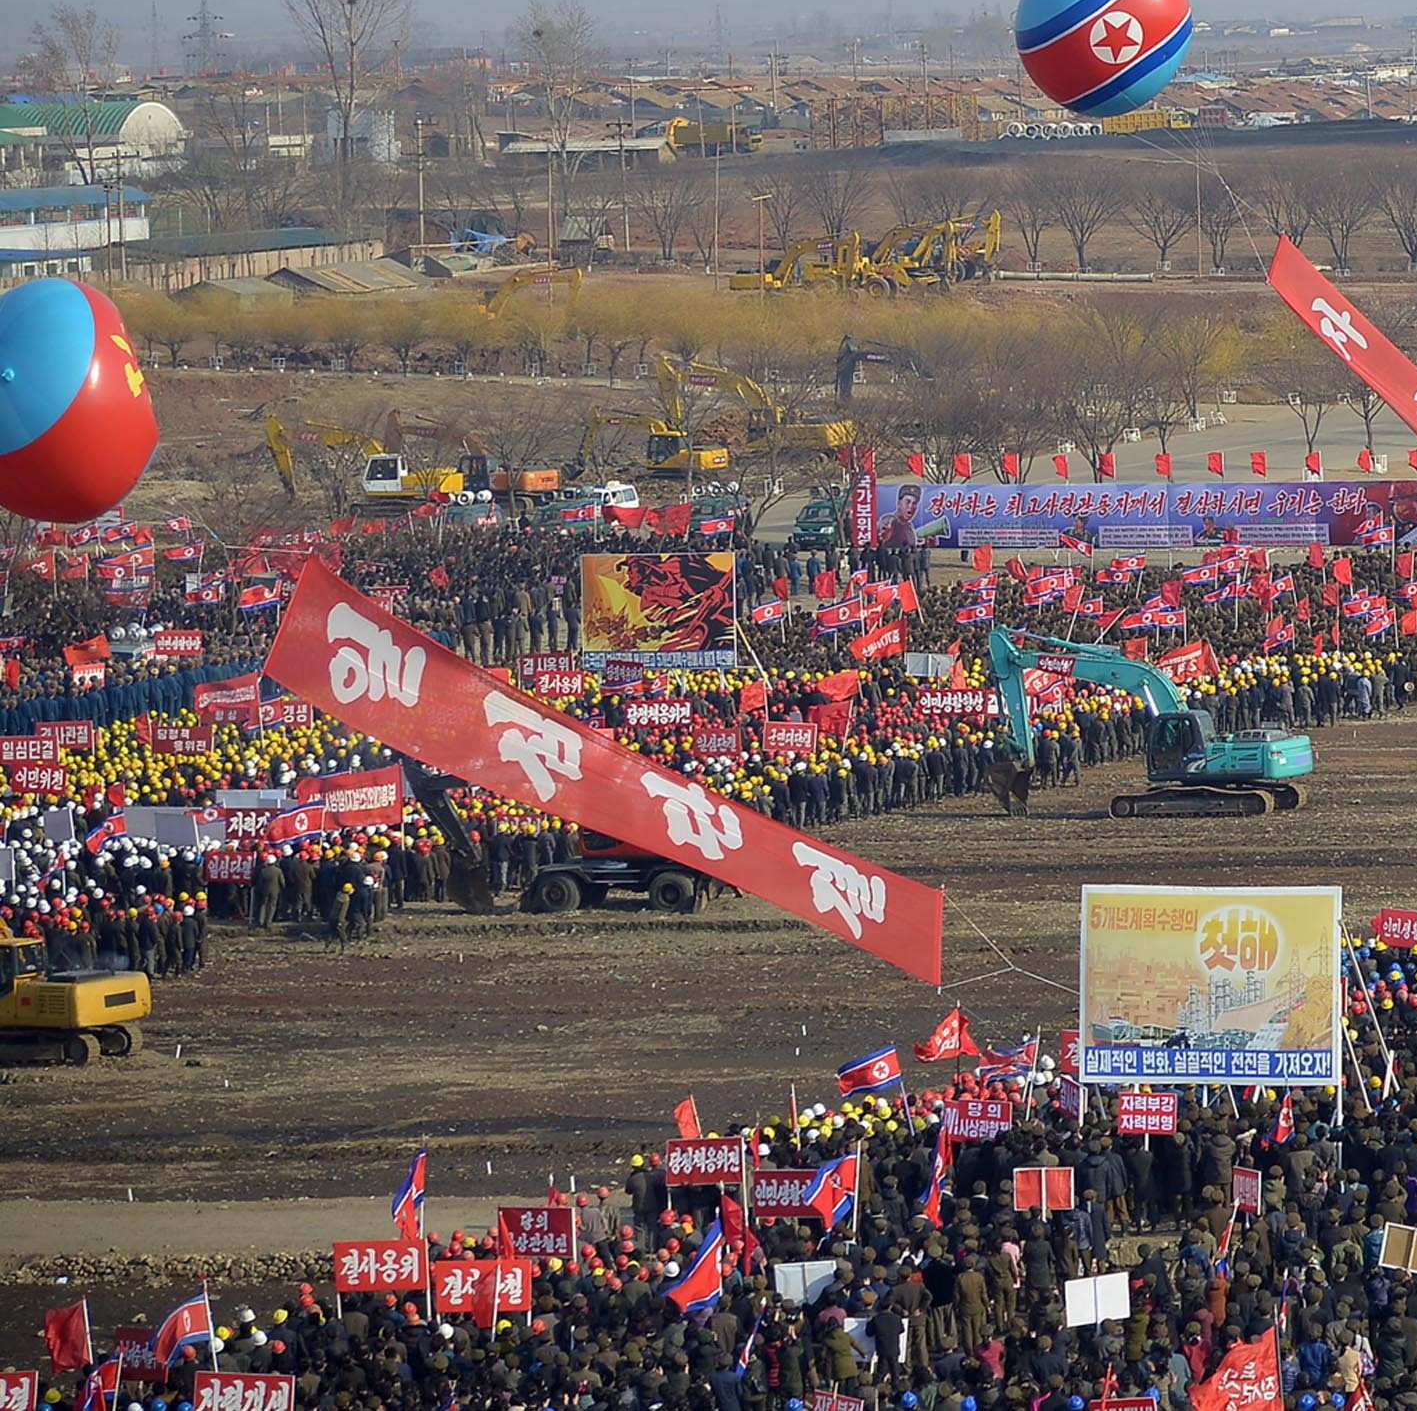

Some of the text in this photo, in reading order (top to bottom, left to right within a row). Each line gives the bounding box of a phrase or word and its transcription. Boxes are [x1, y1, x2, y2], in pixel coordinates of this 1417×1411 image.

[927, 491, 998, 517] 경애하는
[1004, 490, 1168, 518] 최고사령관동지께서
[1267, 488, 1323, 515] 우리는
[1326, 487, 1368, 514] 한다
[537, 675, 582, 694] 결사옹위
[626, 701, 692, 724] 당정책옹위전
[920, 694, 984, 713] 인민생활향상
[2, 740, 54, 760] 일심단결
[15, 766, 64, 789] 이민위천
[327, 602, 885, 939] 일심단결
[1090, 903, 1279, 972] 5개년계획수행의 첫해
[1087, 1049, 1137, 1074] 실제적인
[1174, 1050, 1226, 1075] 실질적인
[1231, 1050, 1271, 1075] 전진을
[1274, 1051, 1331, 1077] 가져오자!
[1121, 1095, 1175, 1112] 자력부강
[1120, 1114, 1174, 1131] 자력번영
[669, 1145, 741, 1175] 당정책옹위전
[512, 1232, 573, 1253] 상관철전
[340, 1246, 420, 1286] 결사옹위
[441, 1267, 523, 1305] 결사철
